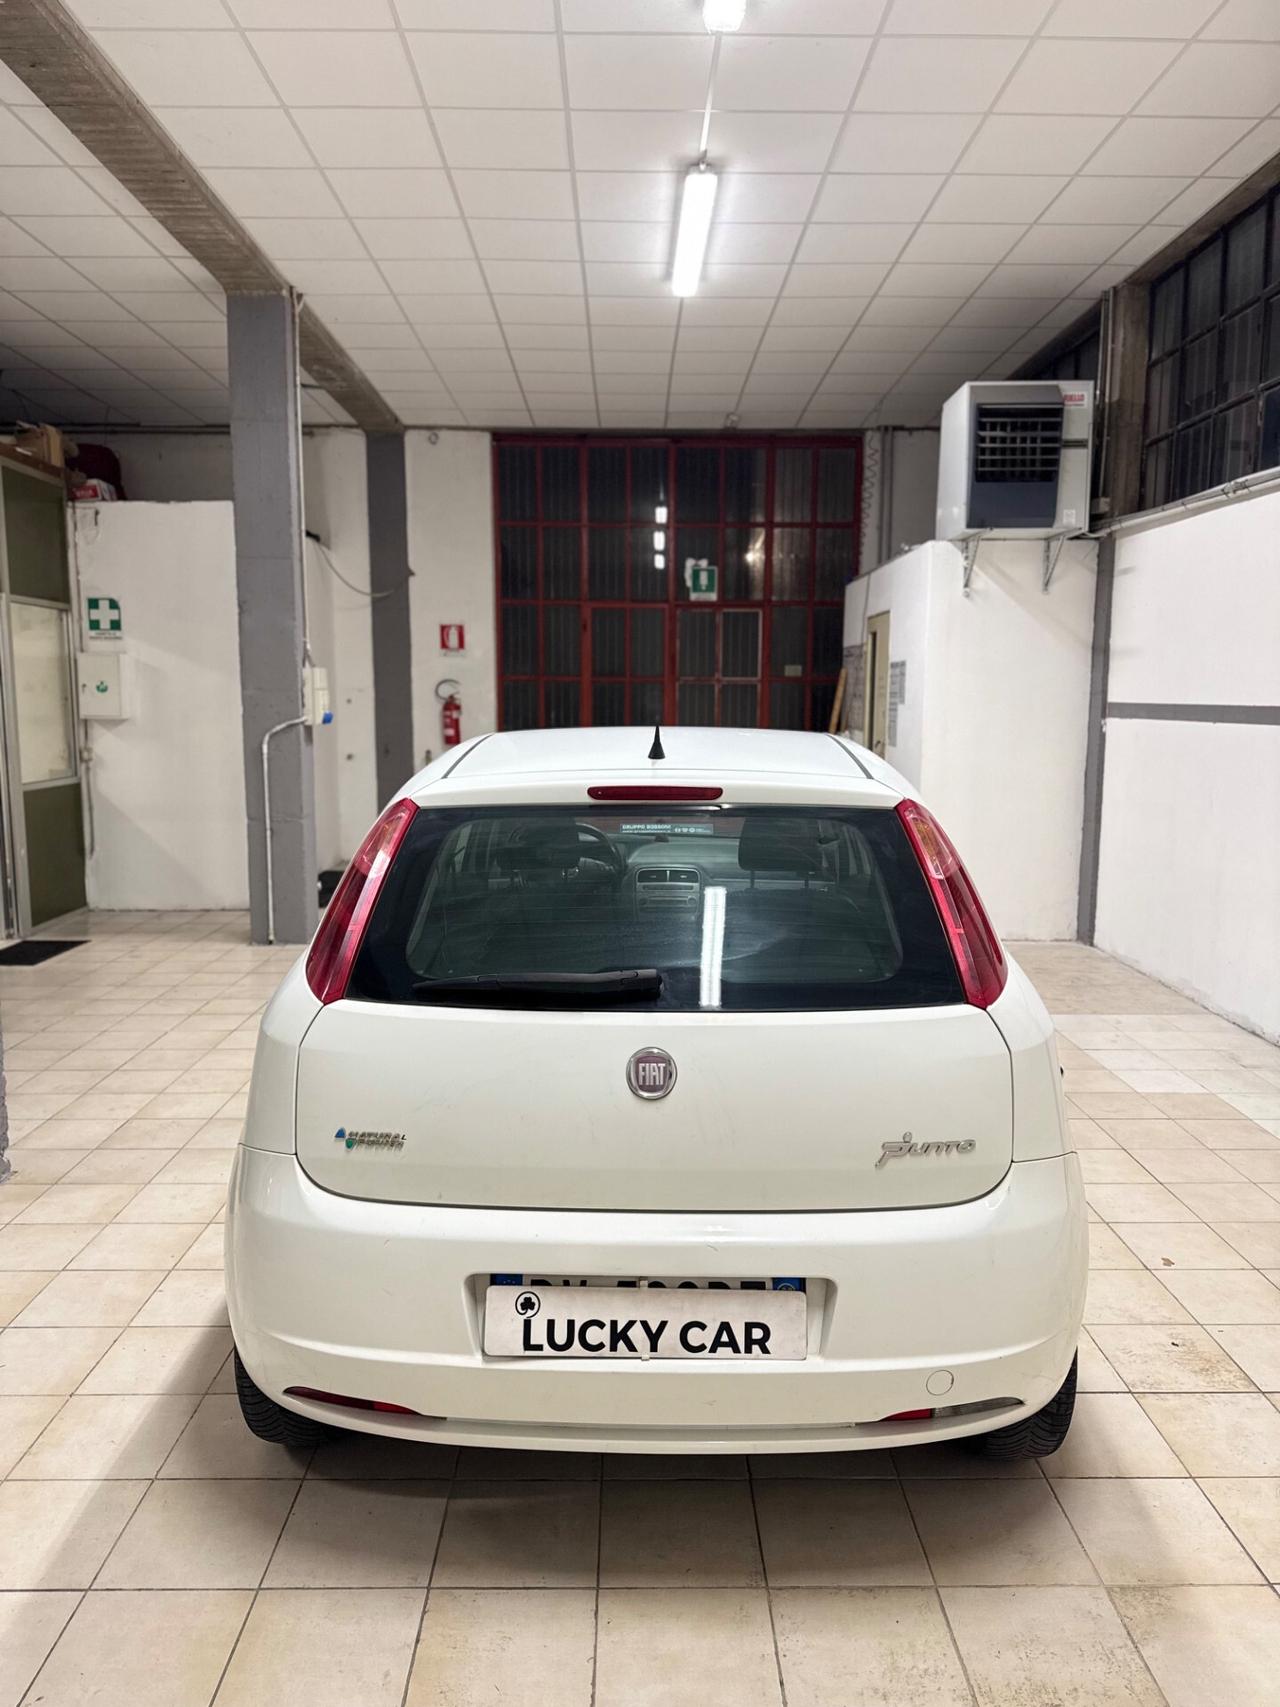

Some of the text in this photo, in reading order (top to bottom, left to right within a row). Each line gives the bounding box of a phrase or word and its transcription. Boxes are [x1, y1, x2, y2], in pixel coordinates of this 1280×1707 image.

[638, 1062, 666, 1086] FIAT
[522, 1318, 772, 1355] LUCKY CAR
